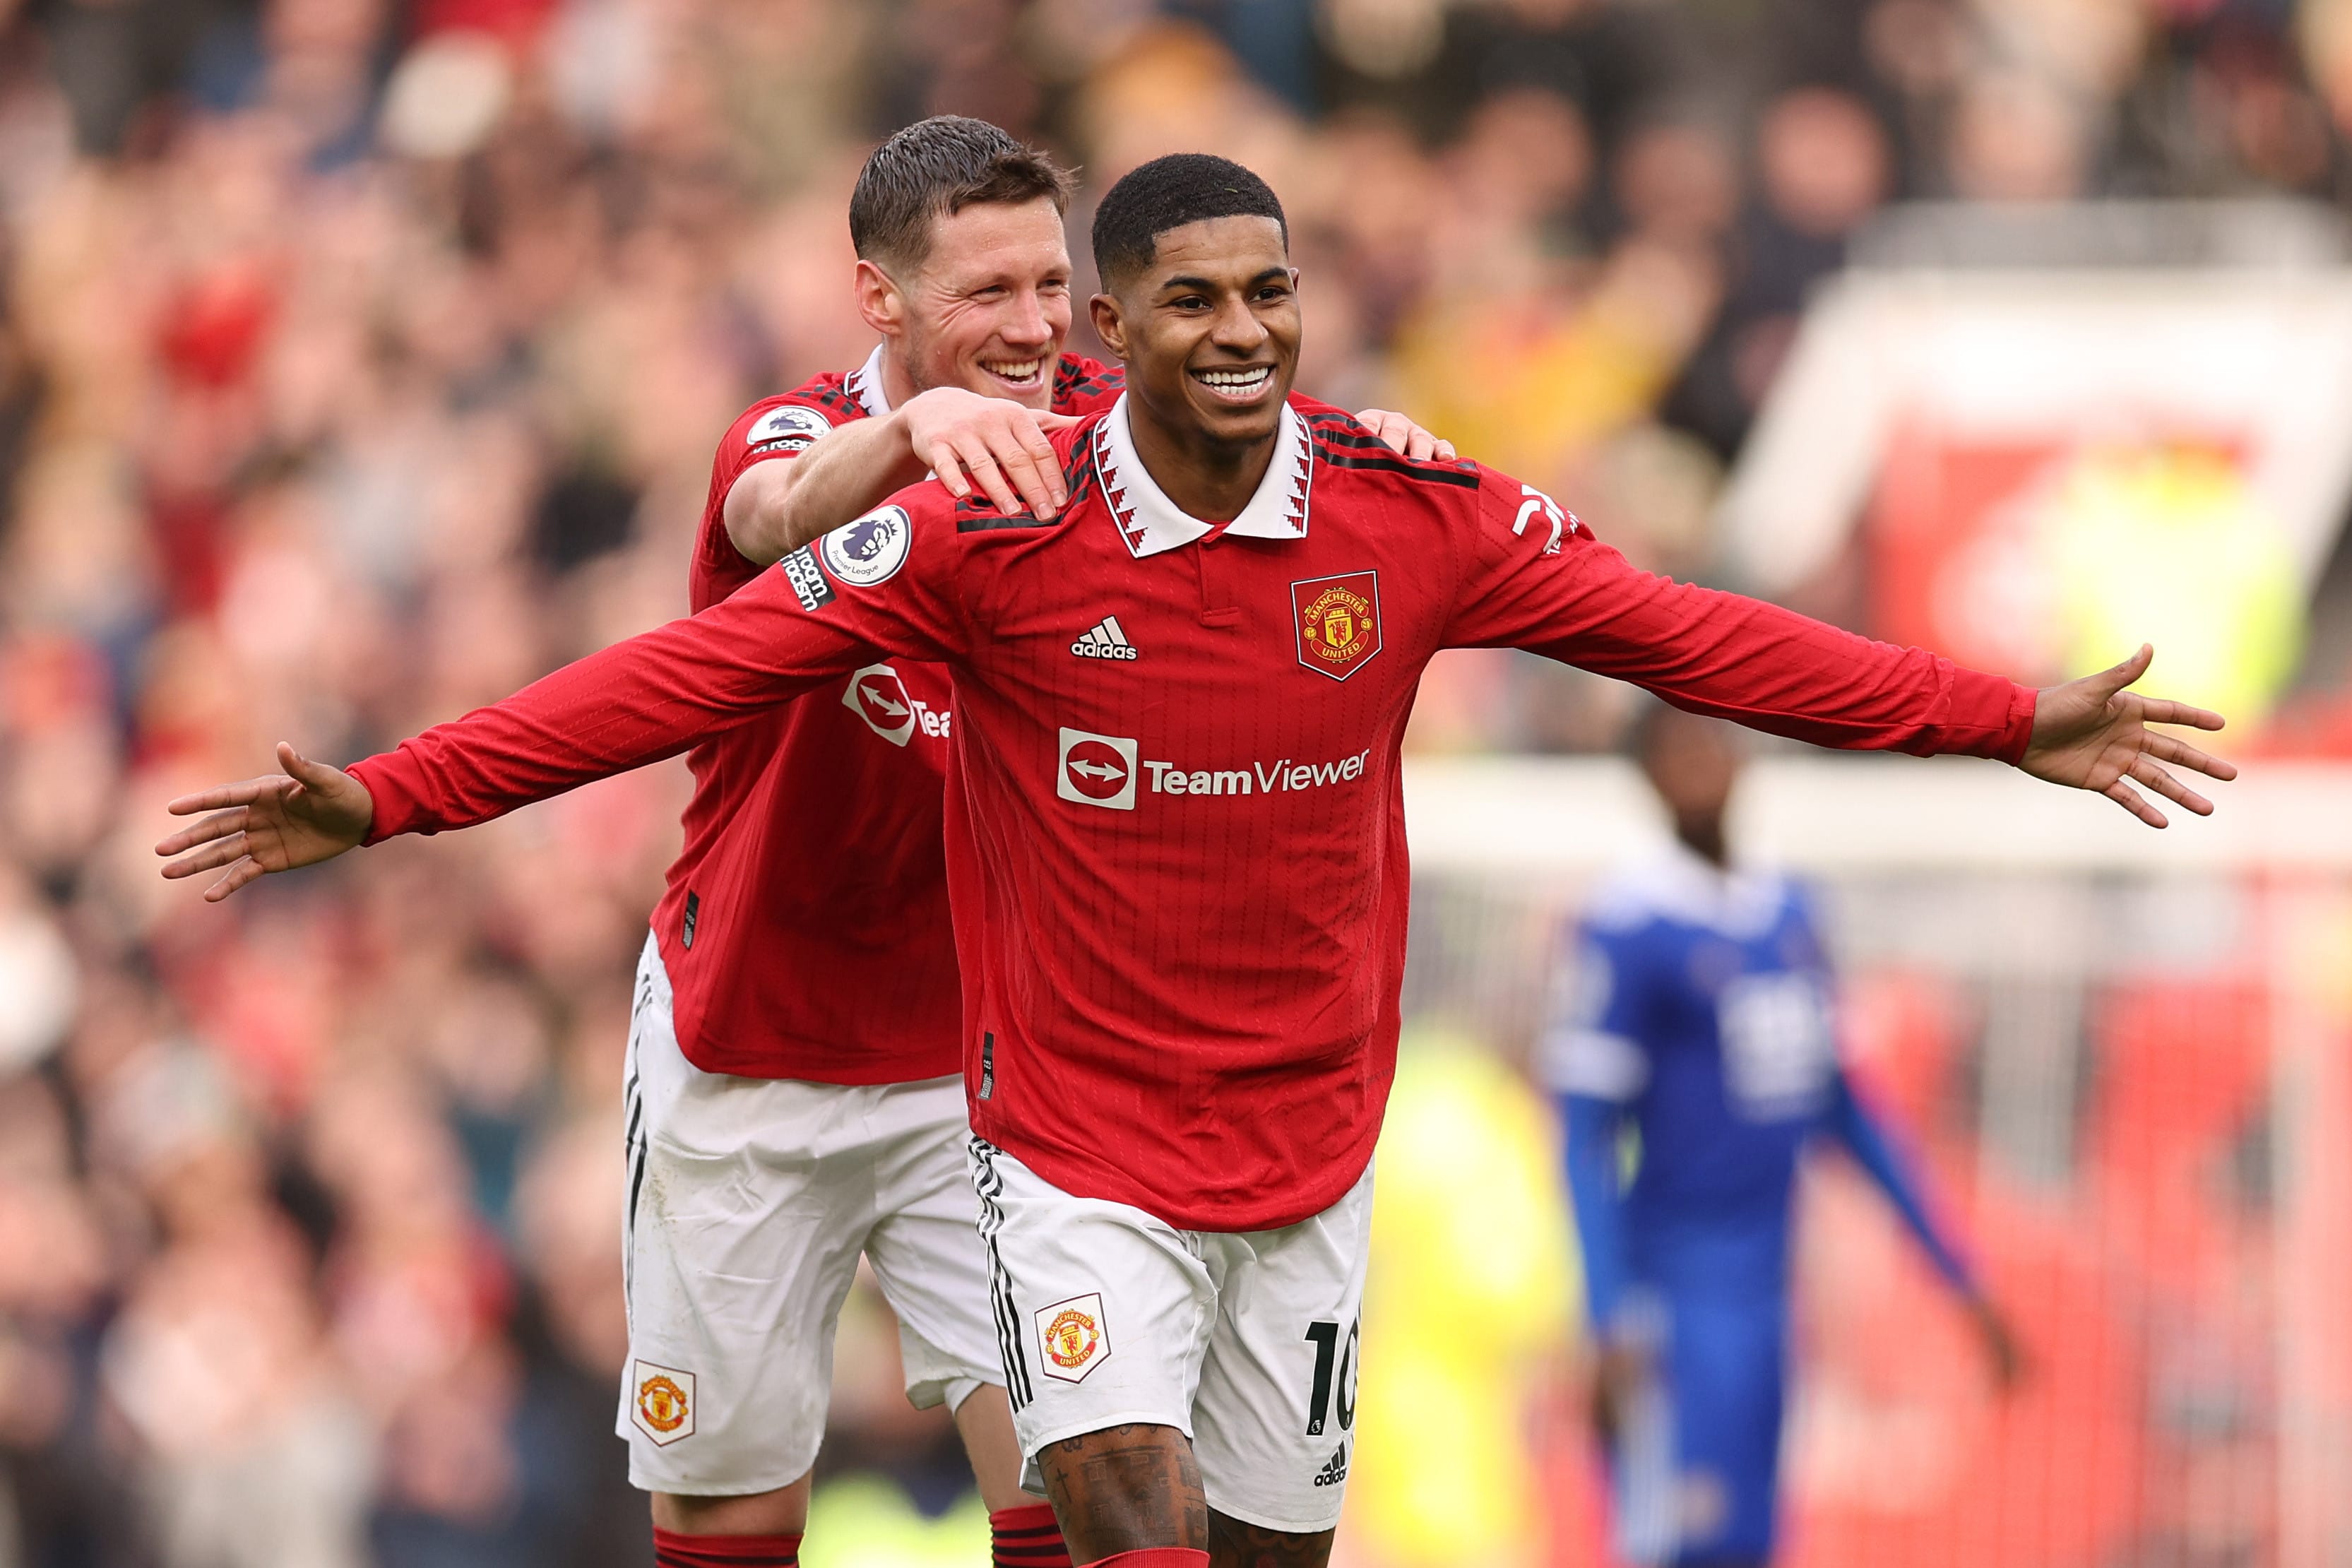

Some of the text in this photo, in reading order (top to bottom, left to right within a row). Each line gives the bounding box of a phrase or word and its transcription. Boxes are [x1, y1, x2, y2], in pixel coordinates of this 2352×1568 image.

[797, 552, 828, 598] room
[832, 550, 879, 576] Premier League
[782, 559, 818, 612] racism
[1309, 593, 1365, 620] MANCHESTER
[1071, 641, 1136, 660] adidas
[1321, 643, 1360, 658] UNITED
[1144, 748, 1370, 795] TeamViewer
[1048, 1313, 1091, 1338] MANCHESTER
[1059, 1350, 1090, 1365] UNITED
[1305, 1317, 1359, 1436] 10
